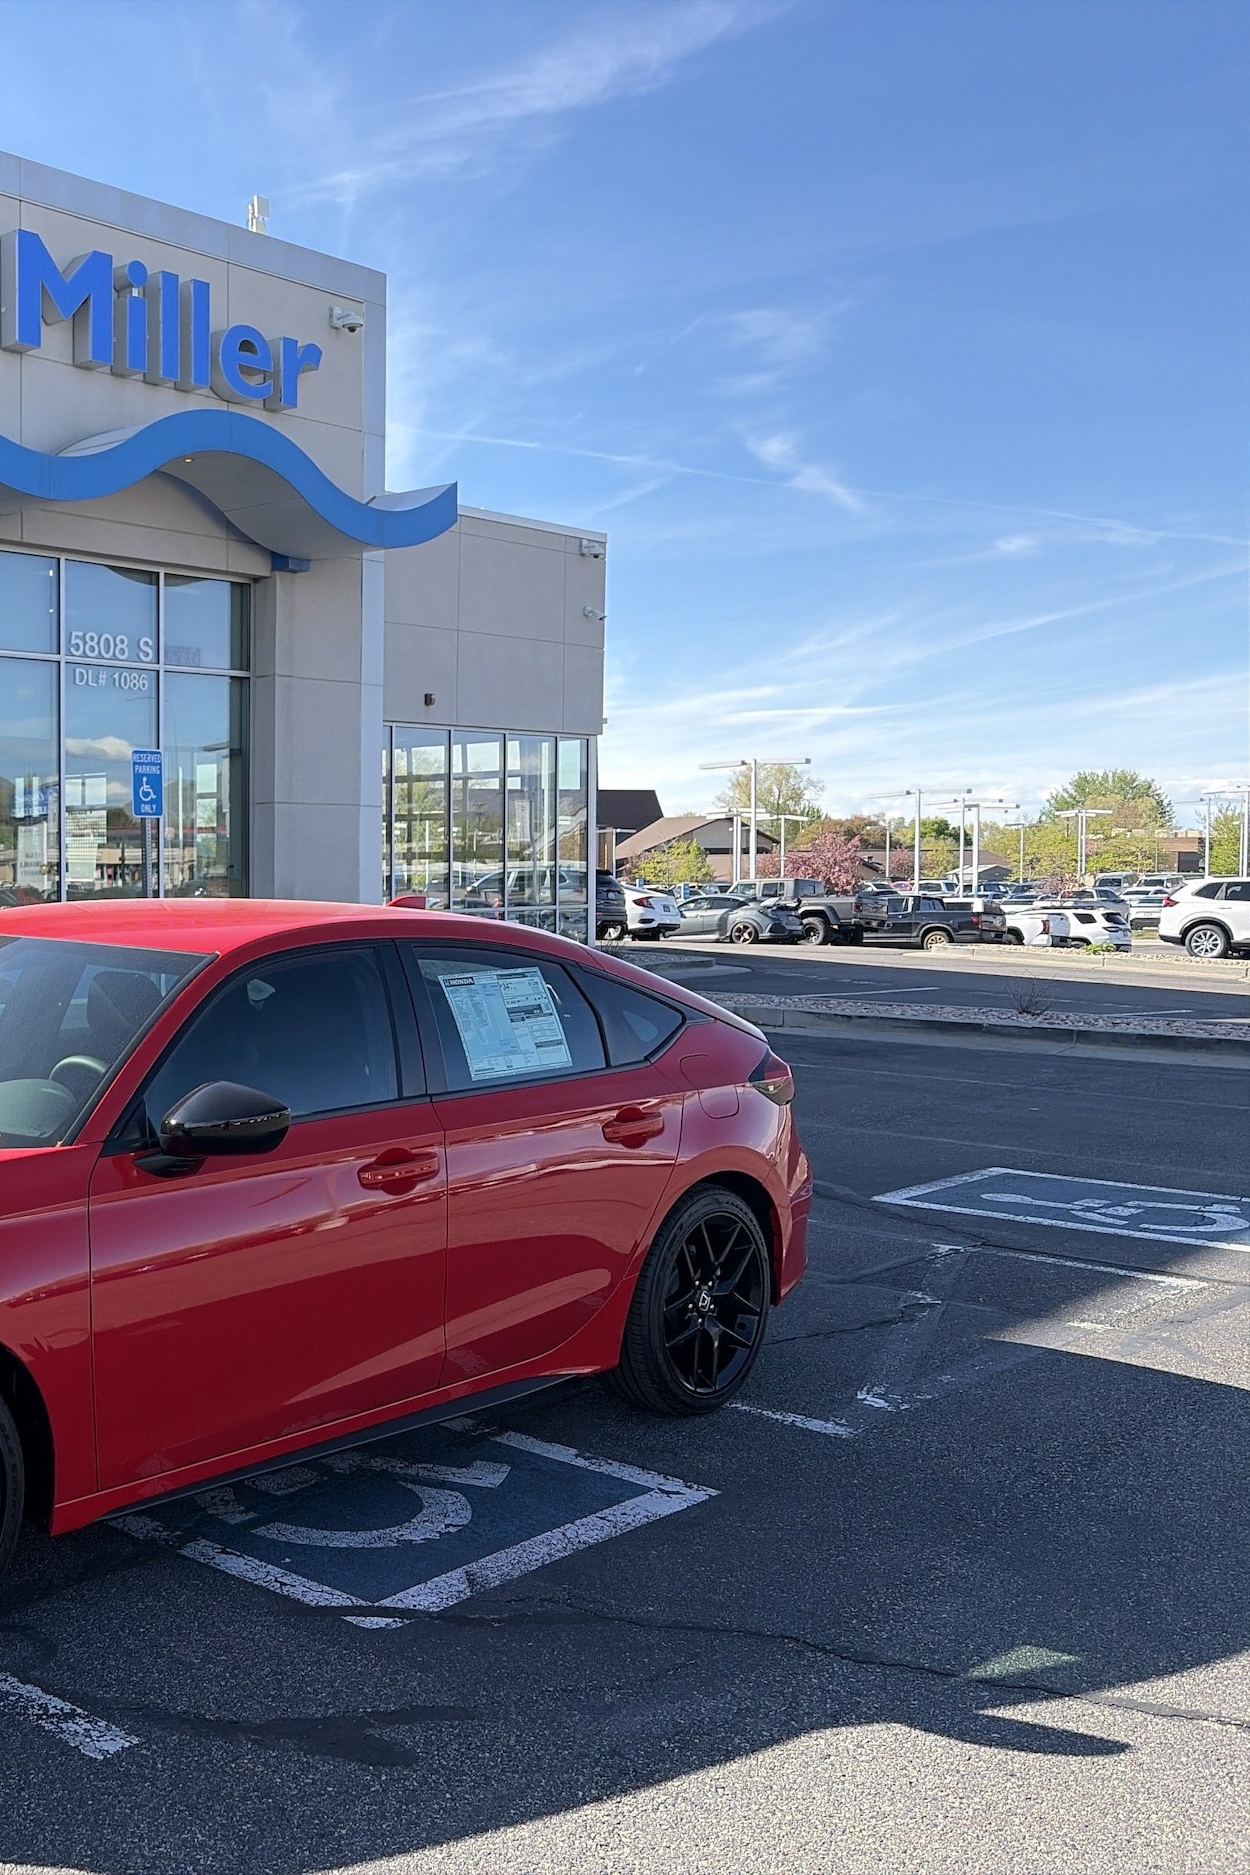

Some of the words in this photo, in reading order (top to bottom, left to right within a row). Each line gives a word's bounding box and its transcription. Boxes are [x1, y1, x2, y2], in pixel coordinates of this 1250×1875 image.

[0, 229, 323, 412] Miller
[70, 630, 129, 660] 5808
[139, 636, 154, 662] S
[74, 667, 108, 688] DL#
[112, 671, 149, 691] 1086
[133, 753, 161, 763] RESERVED
[135, 765, 160, 775] PARKING
[141, 803, 157, 813] ONLY
[450, 977, 474, 986] HONDA
